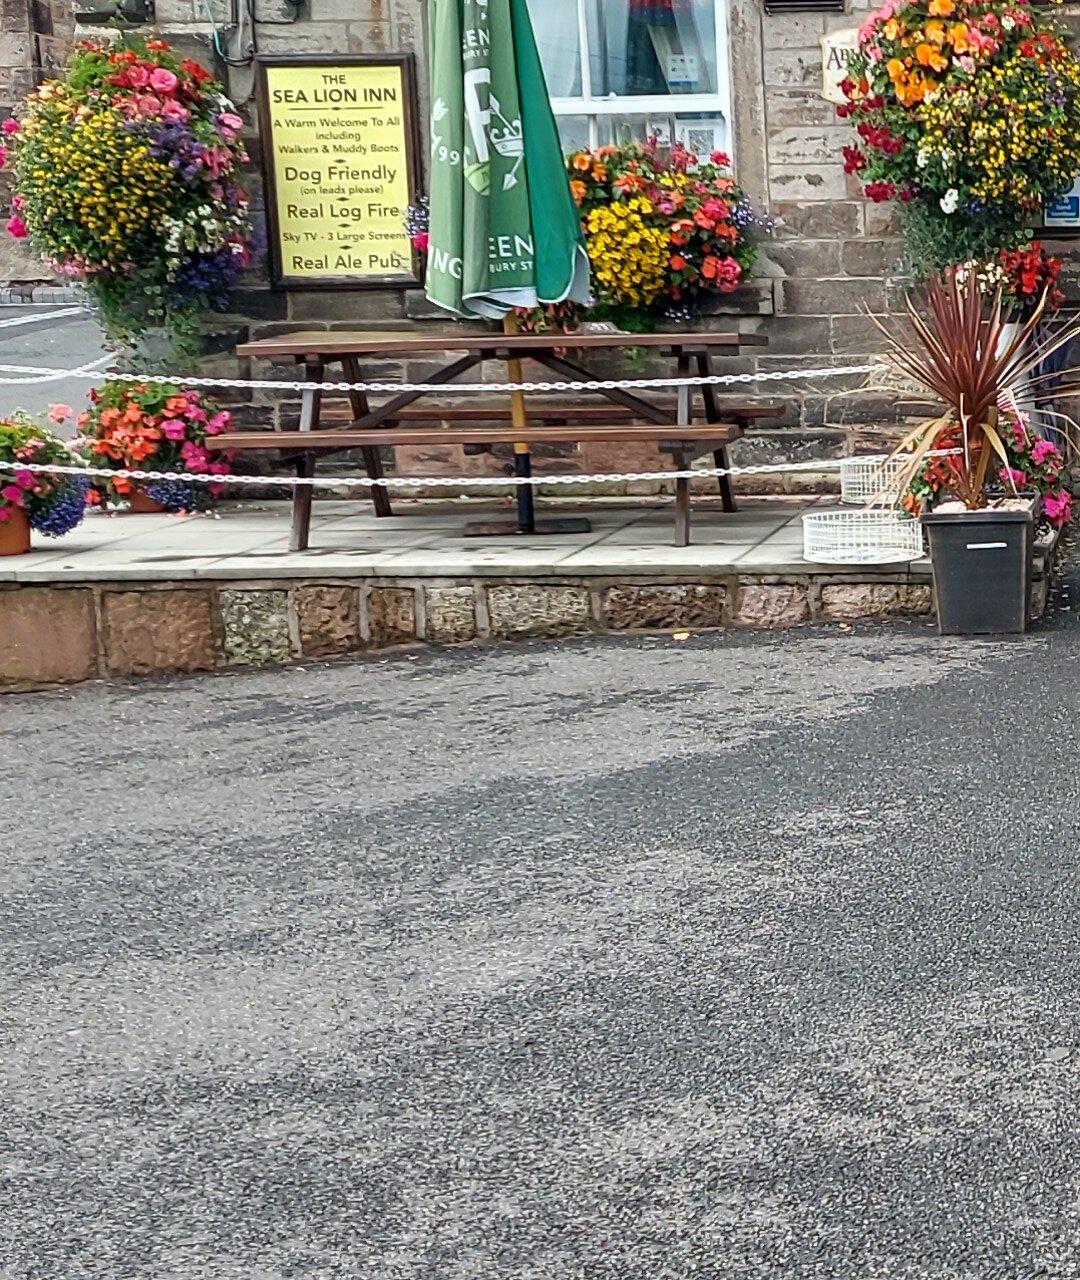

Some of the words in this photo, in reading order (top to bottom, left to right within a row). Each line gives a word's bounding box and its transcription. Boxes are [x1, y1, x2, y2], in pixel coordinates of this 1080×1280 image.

[322, 75, 347, 85] THE
[273, 89, 309, 103] SEA
[314, 88, 357, 103] LION
[364, 87, 397, 102] INN
[274, 119, 282, 128] A
[285, 118, 317, 128] Warm
[319, 117, 368, 127] Welcome
[371, 117, 383, 126] To
[386, 116, 400, 126] All
[316, 131, 361, 141] including
[278, 144, 319, 154] Walkers
[322, 144, 330, 153] &
[333, 144, 367, 155] Muddy
[371, 143, 399, 153] Boots
[285, 167, 322, 185] Dog
[328, 165, 397, 183] Friendly
[300, 186, 316, 195] (on
[320, 185, 346, 195] leads
[349, 184, 384, 196] please)
[287, 203, 324, 218] Real
[330, 204, 361, 221] Log
[367, 203, 400, 217] Fire
[283, 232, 300, 243] Sky
[304, 232, 317, 241] TV
[328, 232, 333, 240] 3
[337, 231, 365, 242] Large
[369, 231, 406, 240] Screens
[292, 255, 329, 269] Real
[334, 254, 362, 269] Ale
[369, 253, 401, 268] Pub
